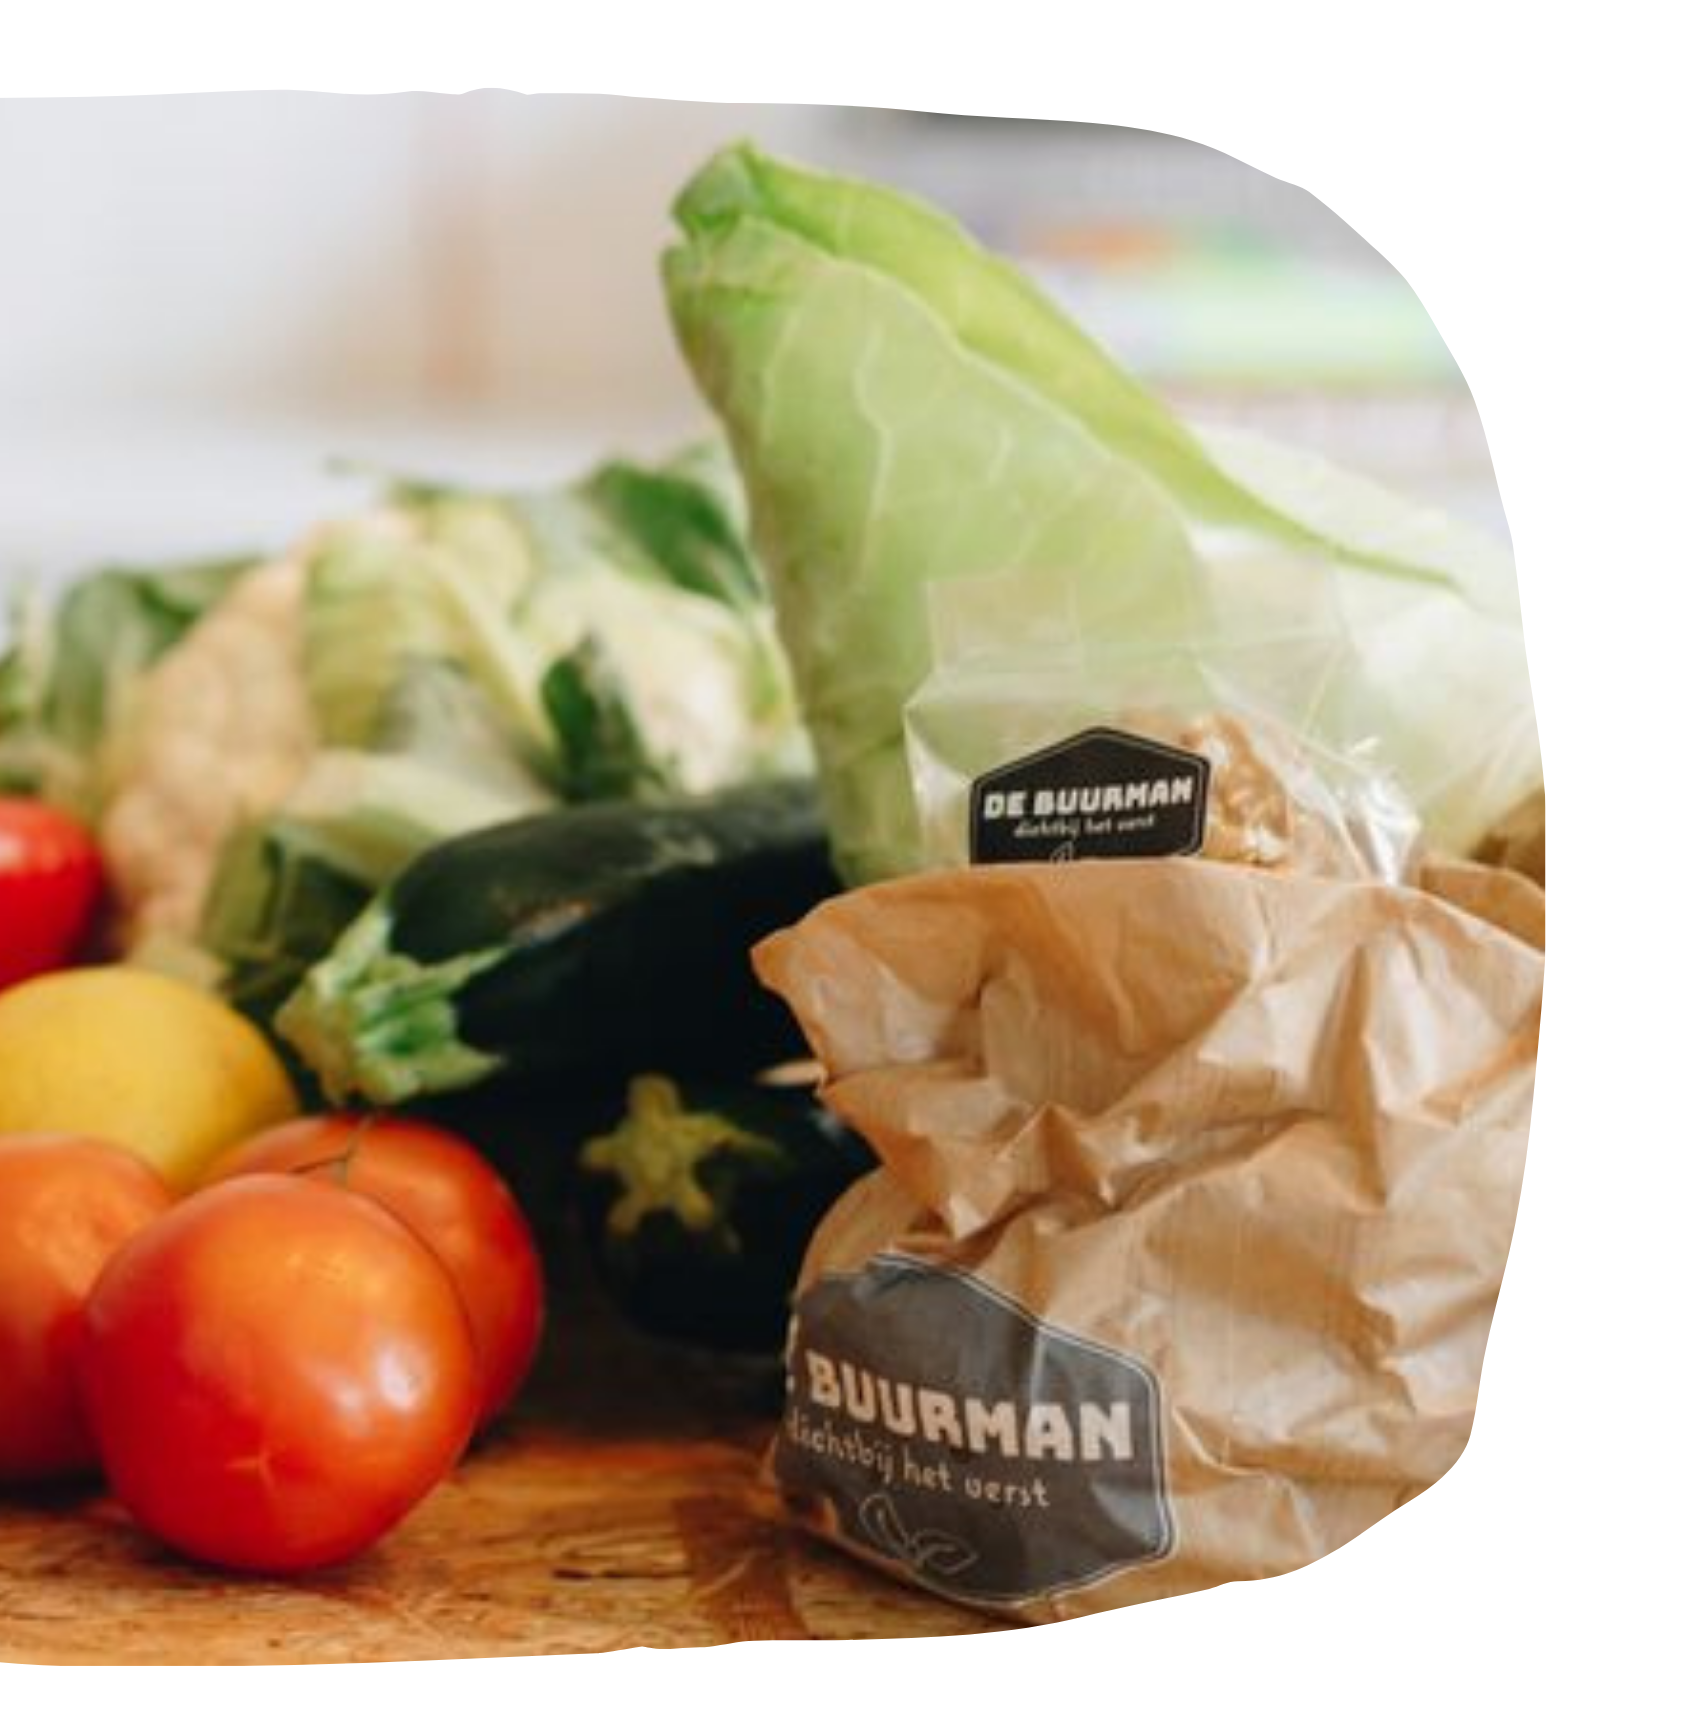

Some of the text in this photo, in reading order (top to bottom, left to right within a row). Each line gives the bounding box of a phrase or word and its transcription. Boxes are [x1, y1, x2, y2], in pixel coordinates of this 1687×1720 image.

[983, 776, 1193, 819] DE BUURMAN
[805, 1350, 1135, 1462] BUURMAN
[903, 1448, 953, 1491] het
